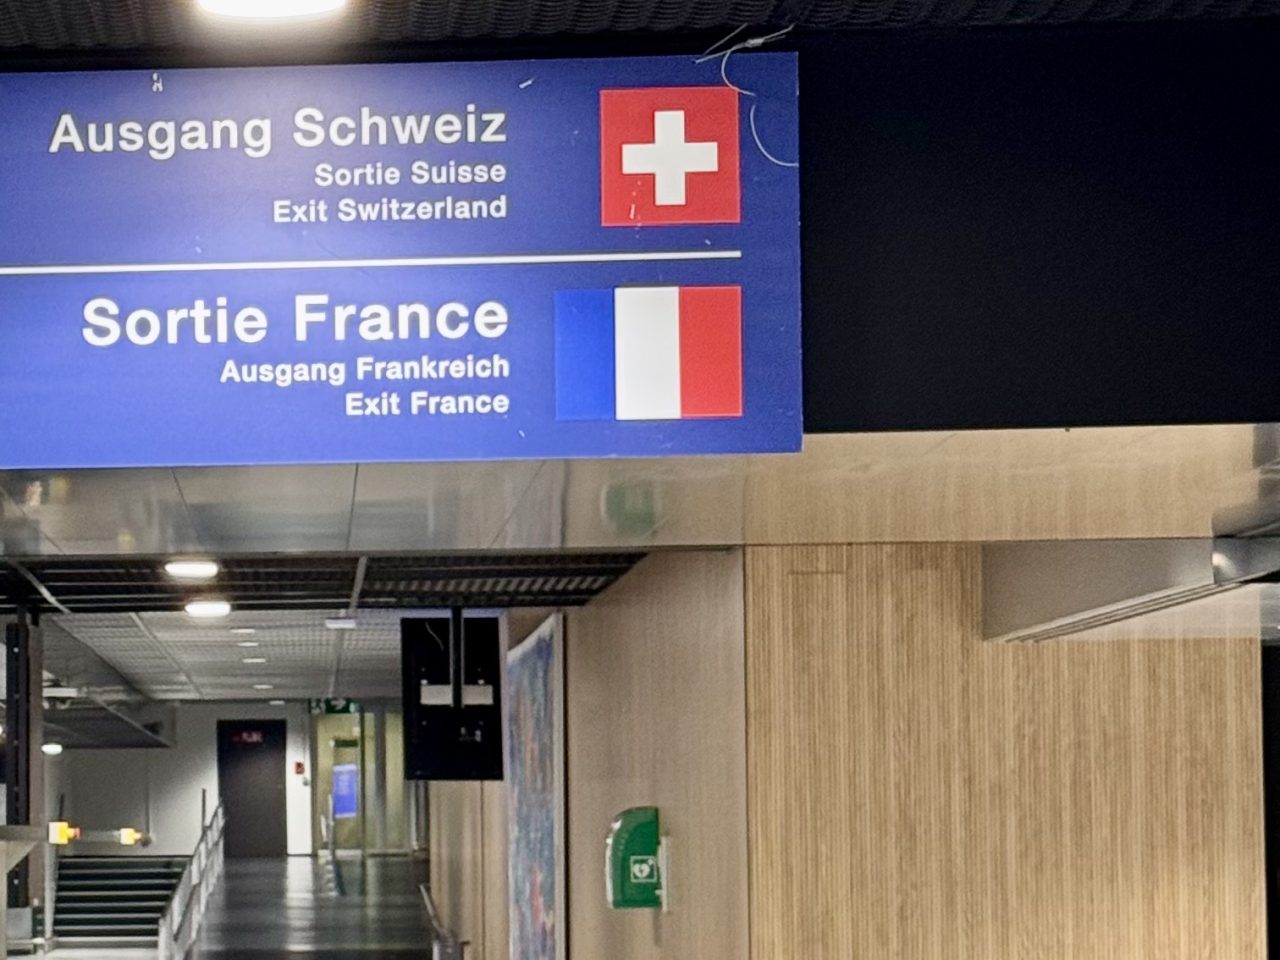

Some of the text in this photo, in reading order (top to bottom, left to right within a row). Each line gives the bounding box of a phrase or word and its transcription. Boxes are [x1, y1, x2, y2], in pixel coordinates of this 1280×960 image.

[48, 103, 507, 160] Ausgang Schweiz
[313, 159, 507, 188] Sortie Suisse
[272, 194, 507, 224] Exit Switzerland
[81, 292, 509, 348] Sortie France
[219, 353, 510, 388] Ausgang Frankreich
[344, 390, 511, 417] Exit France
